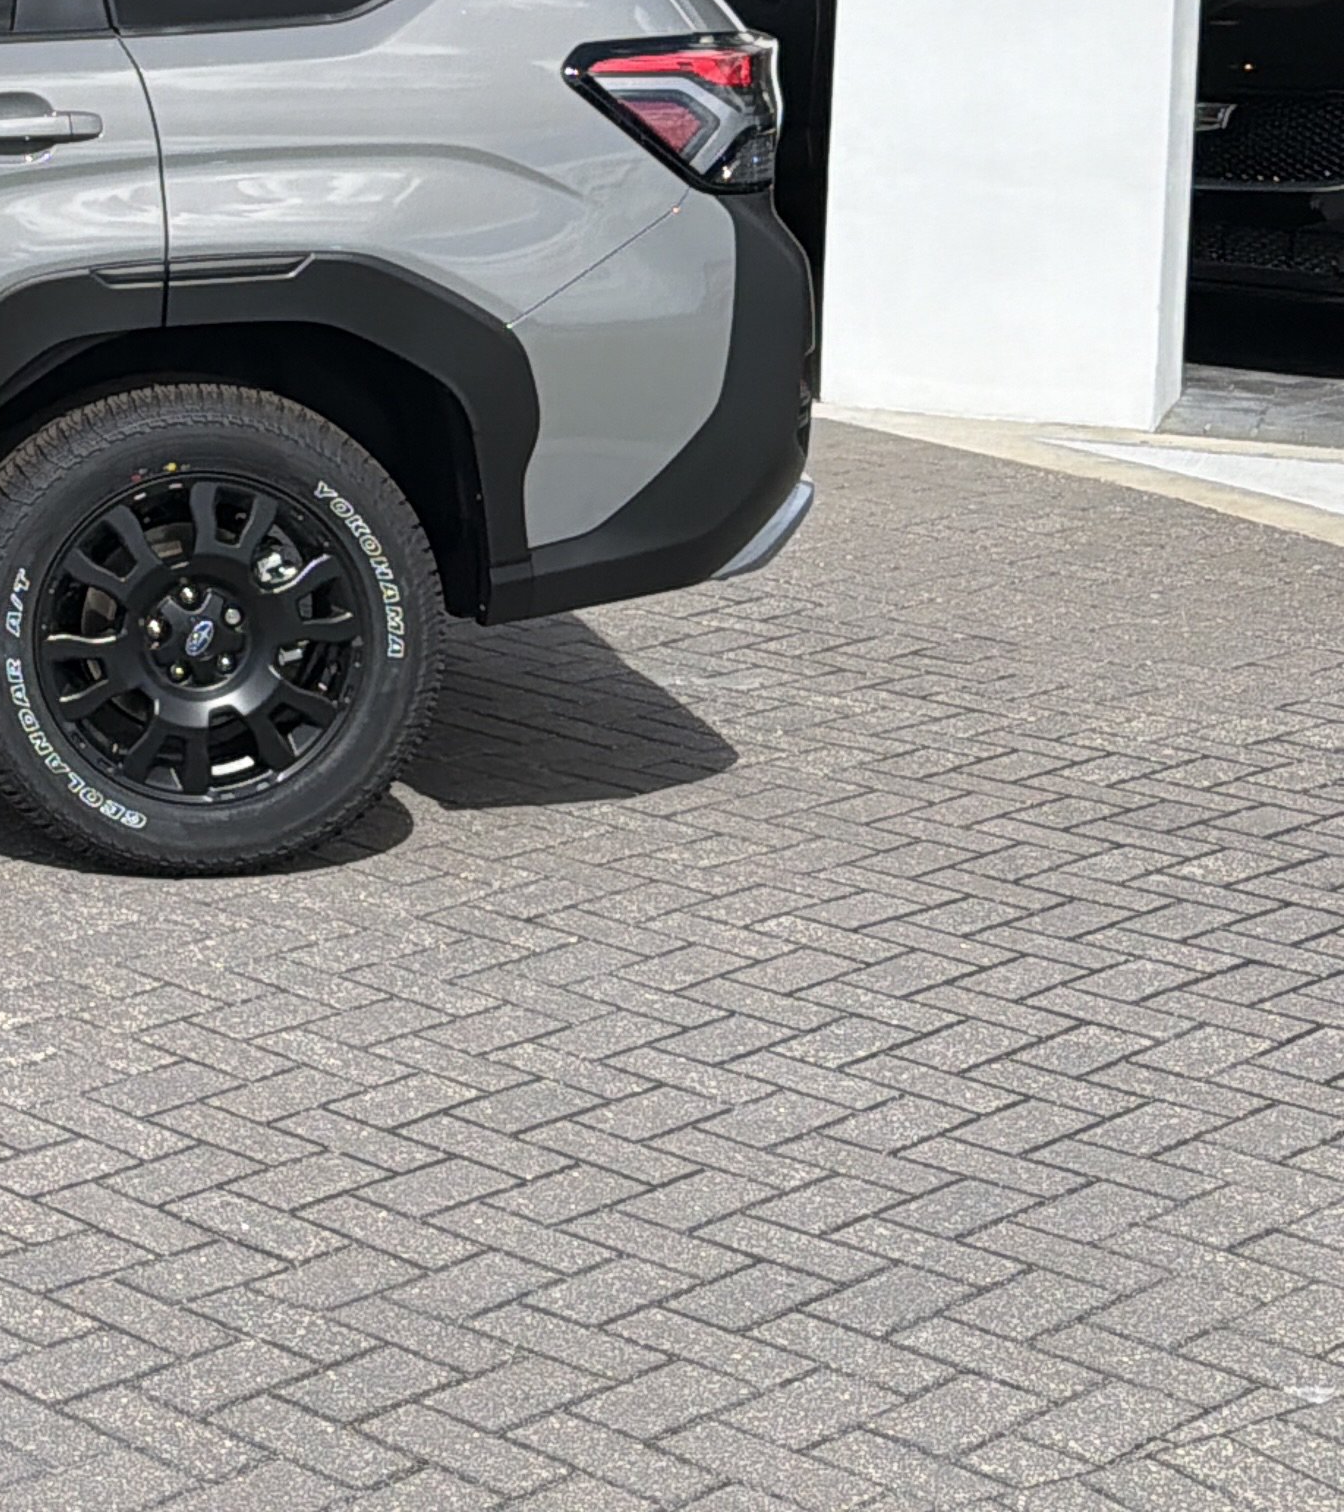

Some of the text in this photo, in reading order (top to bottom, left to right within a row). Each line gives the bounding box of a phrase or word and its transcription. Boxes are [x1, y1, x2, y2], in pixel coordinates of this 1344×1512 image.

[314, 480, 405, 659] YOKOHAMA
[5, 567, 148, 830] GEOLANDAR A/T
